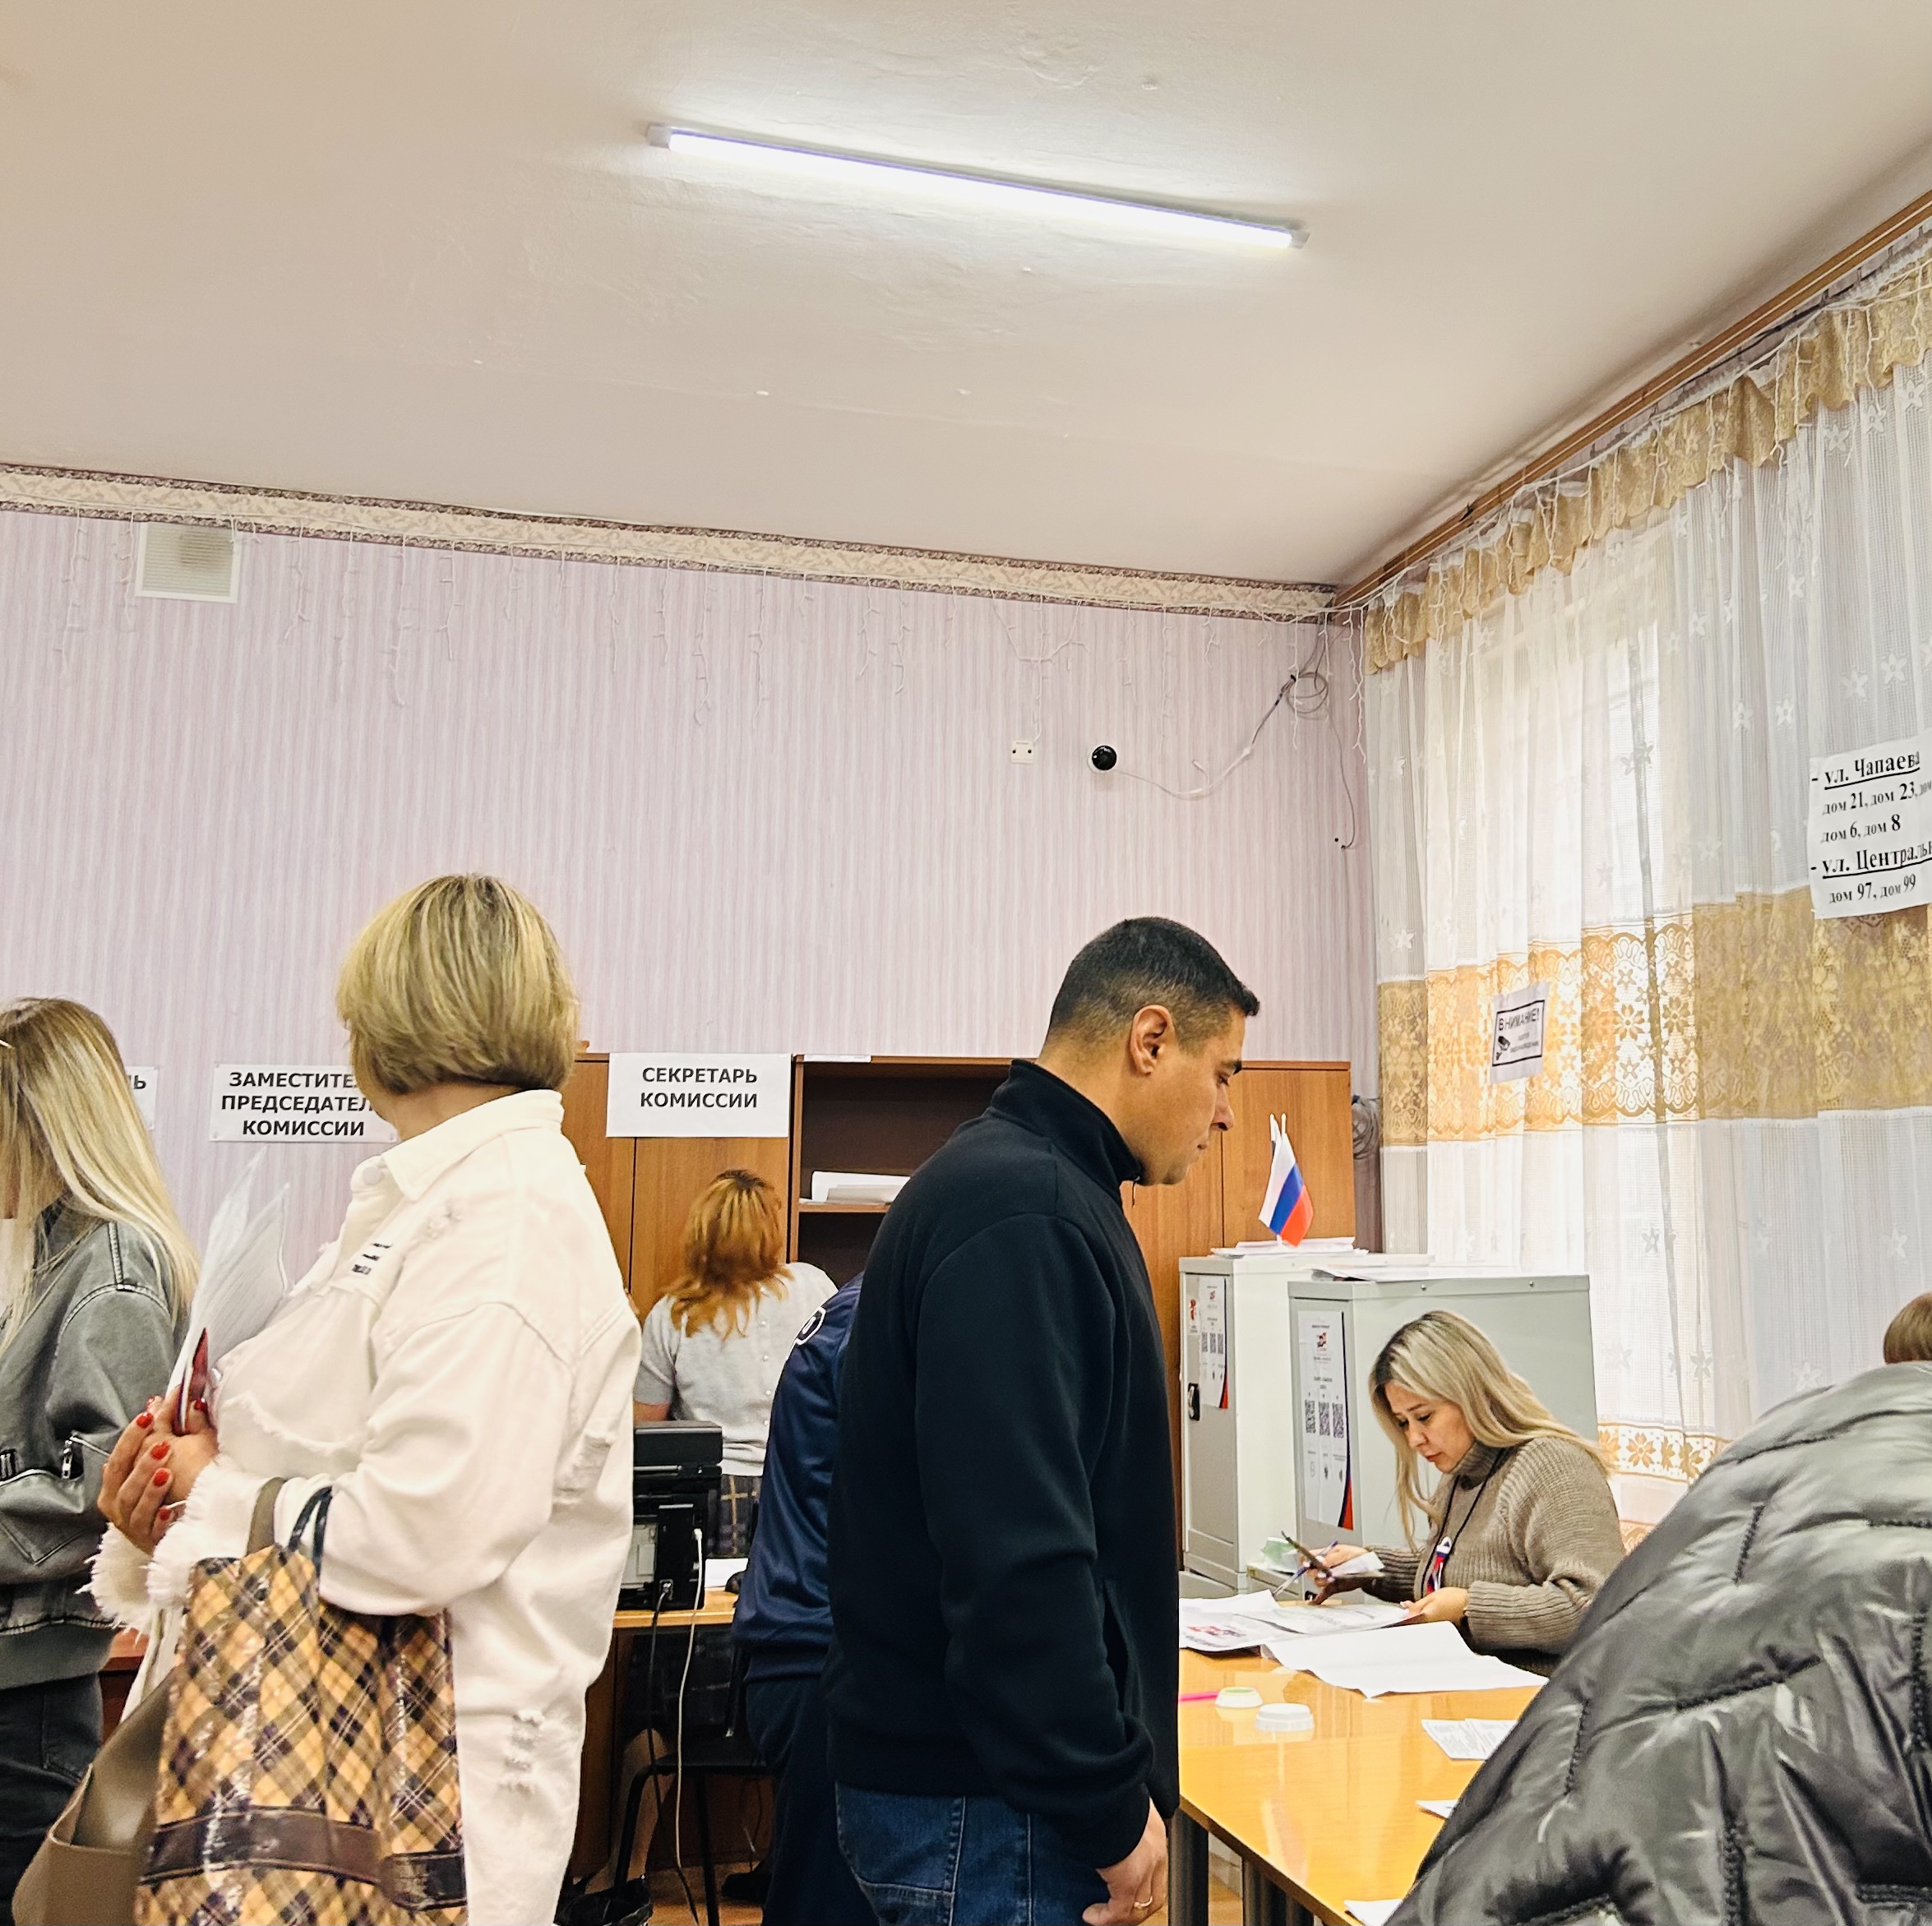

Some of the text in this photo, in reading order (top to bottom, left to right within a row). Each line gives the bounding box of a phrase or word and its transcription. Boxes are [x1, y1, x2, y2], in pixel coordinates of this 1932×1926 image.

[1824, 769, 1849, 785] ул.
[1822, 801, 1846, 815] дом
[1850, 791, 1869, 810] 21,
[1870, 791, 1894, 806] дом
[1898, 781, 1918, 801] 23,
[1819, 814, 1901, 843] дом 6, дом 8
[1822, 858, 1850, 874] ул.
[1828, 873, 1916, 905] дом 97, дом 99
[229, 1071, 358, 1089] ЗАМЕСТИТЕ
[641, 1067, 758, 1083] СЕКРЕТАРЬ
[220, 1094, 374, 1114] ПРЕДСЕДАТЕЛ
[640, 1092, 758, 1108] КОМИССИИ
[242, 1119, 365, 1137] КОМИССИИ
